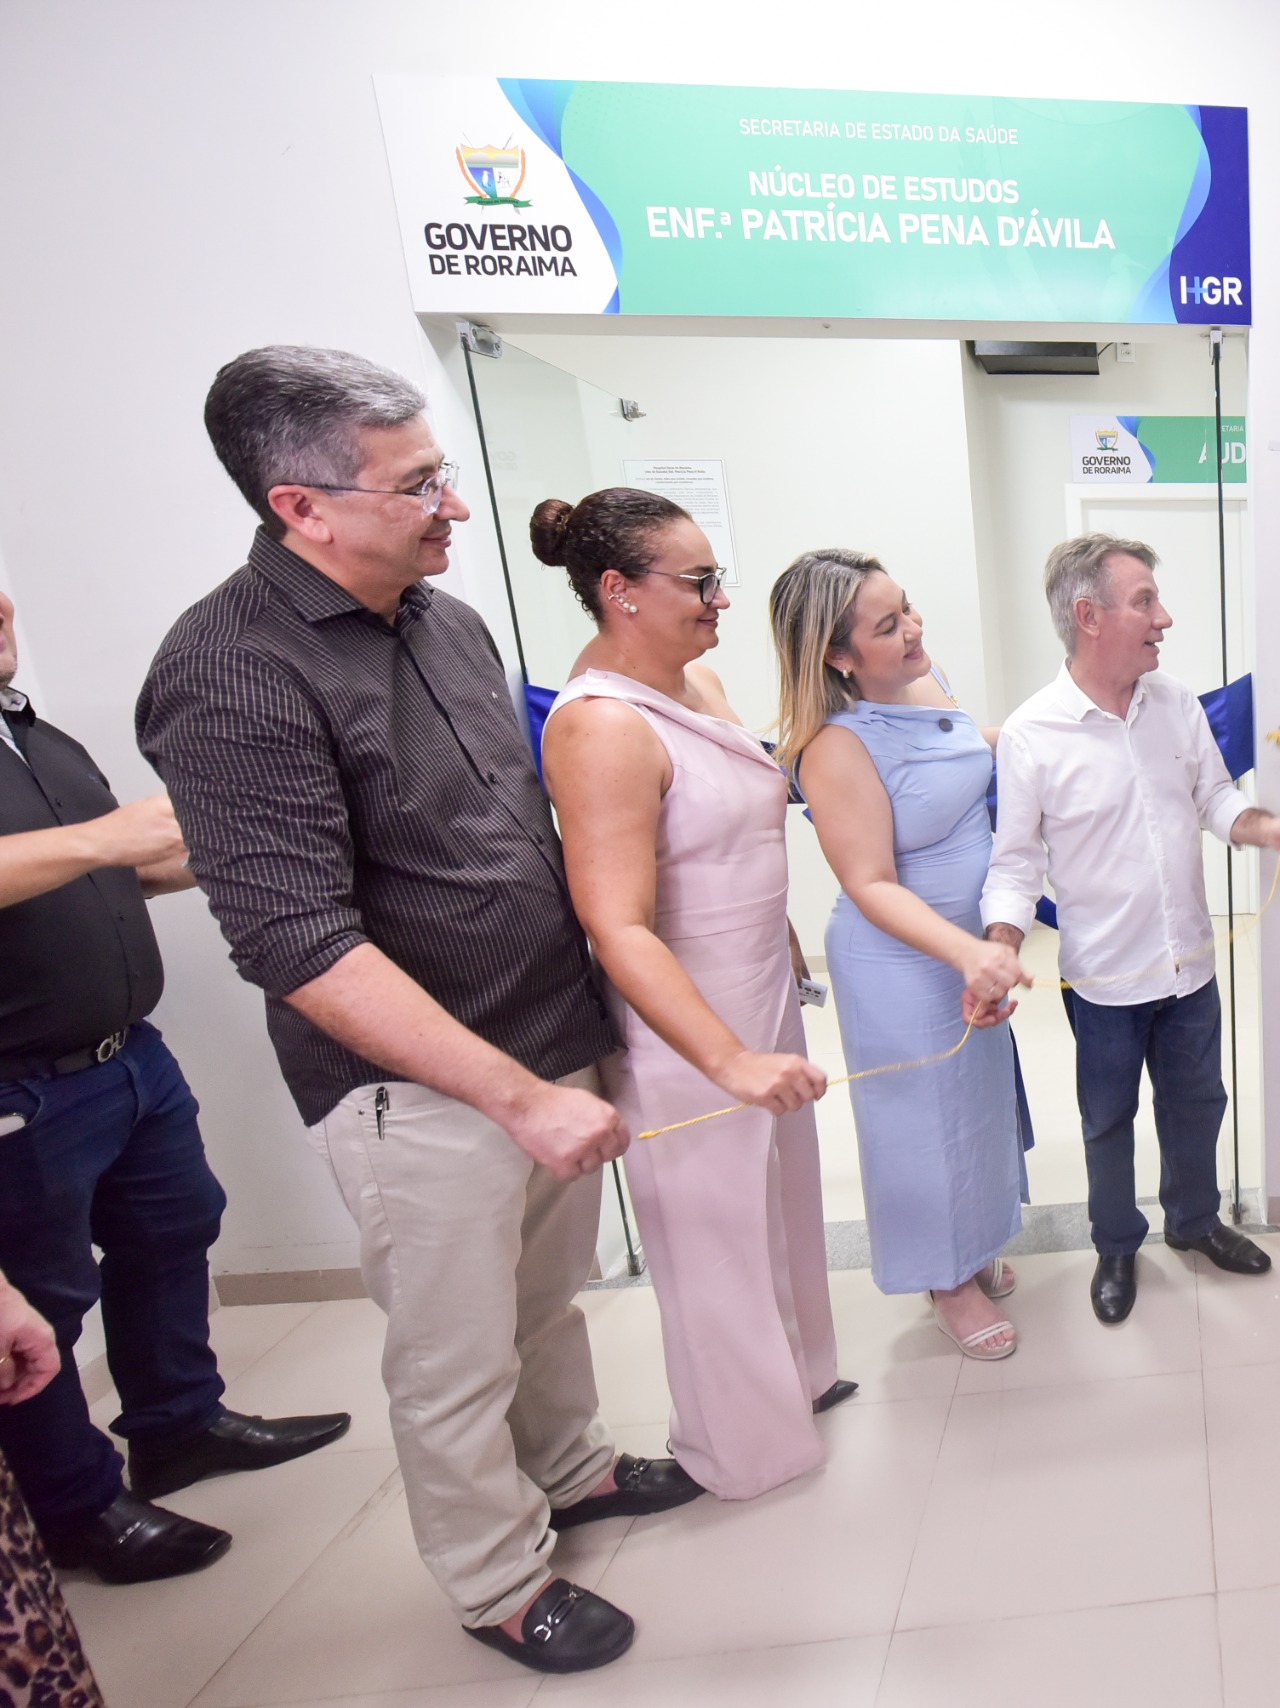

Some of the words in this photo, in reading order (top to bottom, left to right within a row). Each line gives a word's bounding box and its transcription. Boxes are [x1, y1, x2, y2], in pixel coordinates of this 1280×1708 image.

[739, 118, 841, 138] SECRETARIA
[845, 122, 867, 140] DE
[871, 123, 934, 142] ESTADO
[938, 126, 961, 143] DA
[965, 124, 1019, 145] SAÚDE
[748, 164, 855, 199] NÚCLEO
[862, 174, 898, 200] DE
[903, 175, 1020, 204] ESTUDOS
[424, 222, 573, 253] GOVERNO
[740, 201, 892, 243] PATRÍCIA
[898, 212, 990, 246] PENA
[997, 207, 1116, 249] D'ÁVILA
[428, 254, 462, 275] DE
[464, 255, 578, 277] RORAIMA
[1179, 275, 1244, 306] HGR
[1082, 456, 1131, 466] GOVERNO
[1082, 466, 1094, 475] DE
[1094, 466, 1132, 475] RORAIMA
